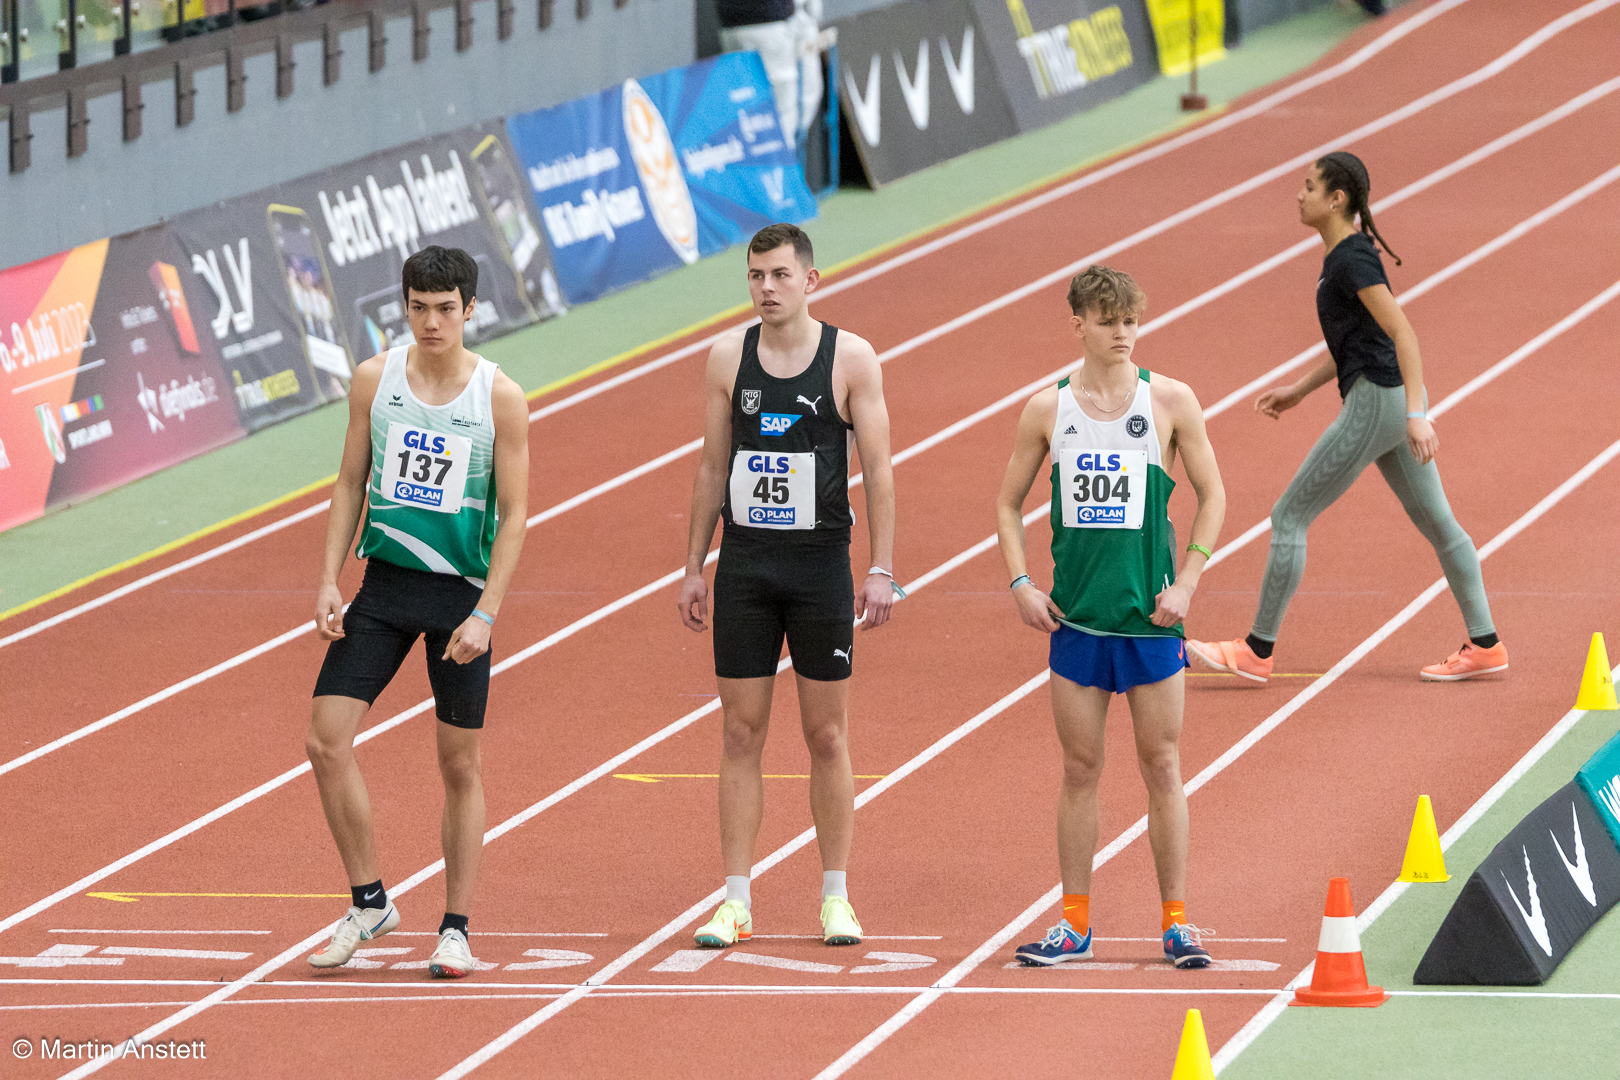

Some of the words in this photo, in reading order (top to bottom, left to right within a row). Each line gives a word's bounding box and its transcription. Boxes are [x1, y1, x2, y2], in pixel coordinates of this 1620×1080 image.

[317, 190, 383, 267] Jetzt
[366, 174, 421, 262] App
[400, 149, 480, 235] laden!
[761, 416, 792, 433] SAP
[397, 450, 453, 486] 137
[413, 488, 442, 501] PLAN
[753, 476, 790, 505] 45
[1073, 474, 1131, 503] 304
[767, 510, 794, 519] PLAN
[1096, 509, 1124, 518] PLAN
